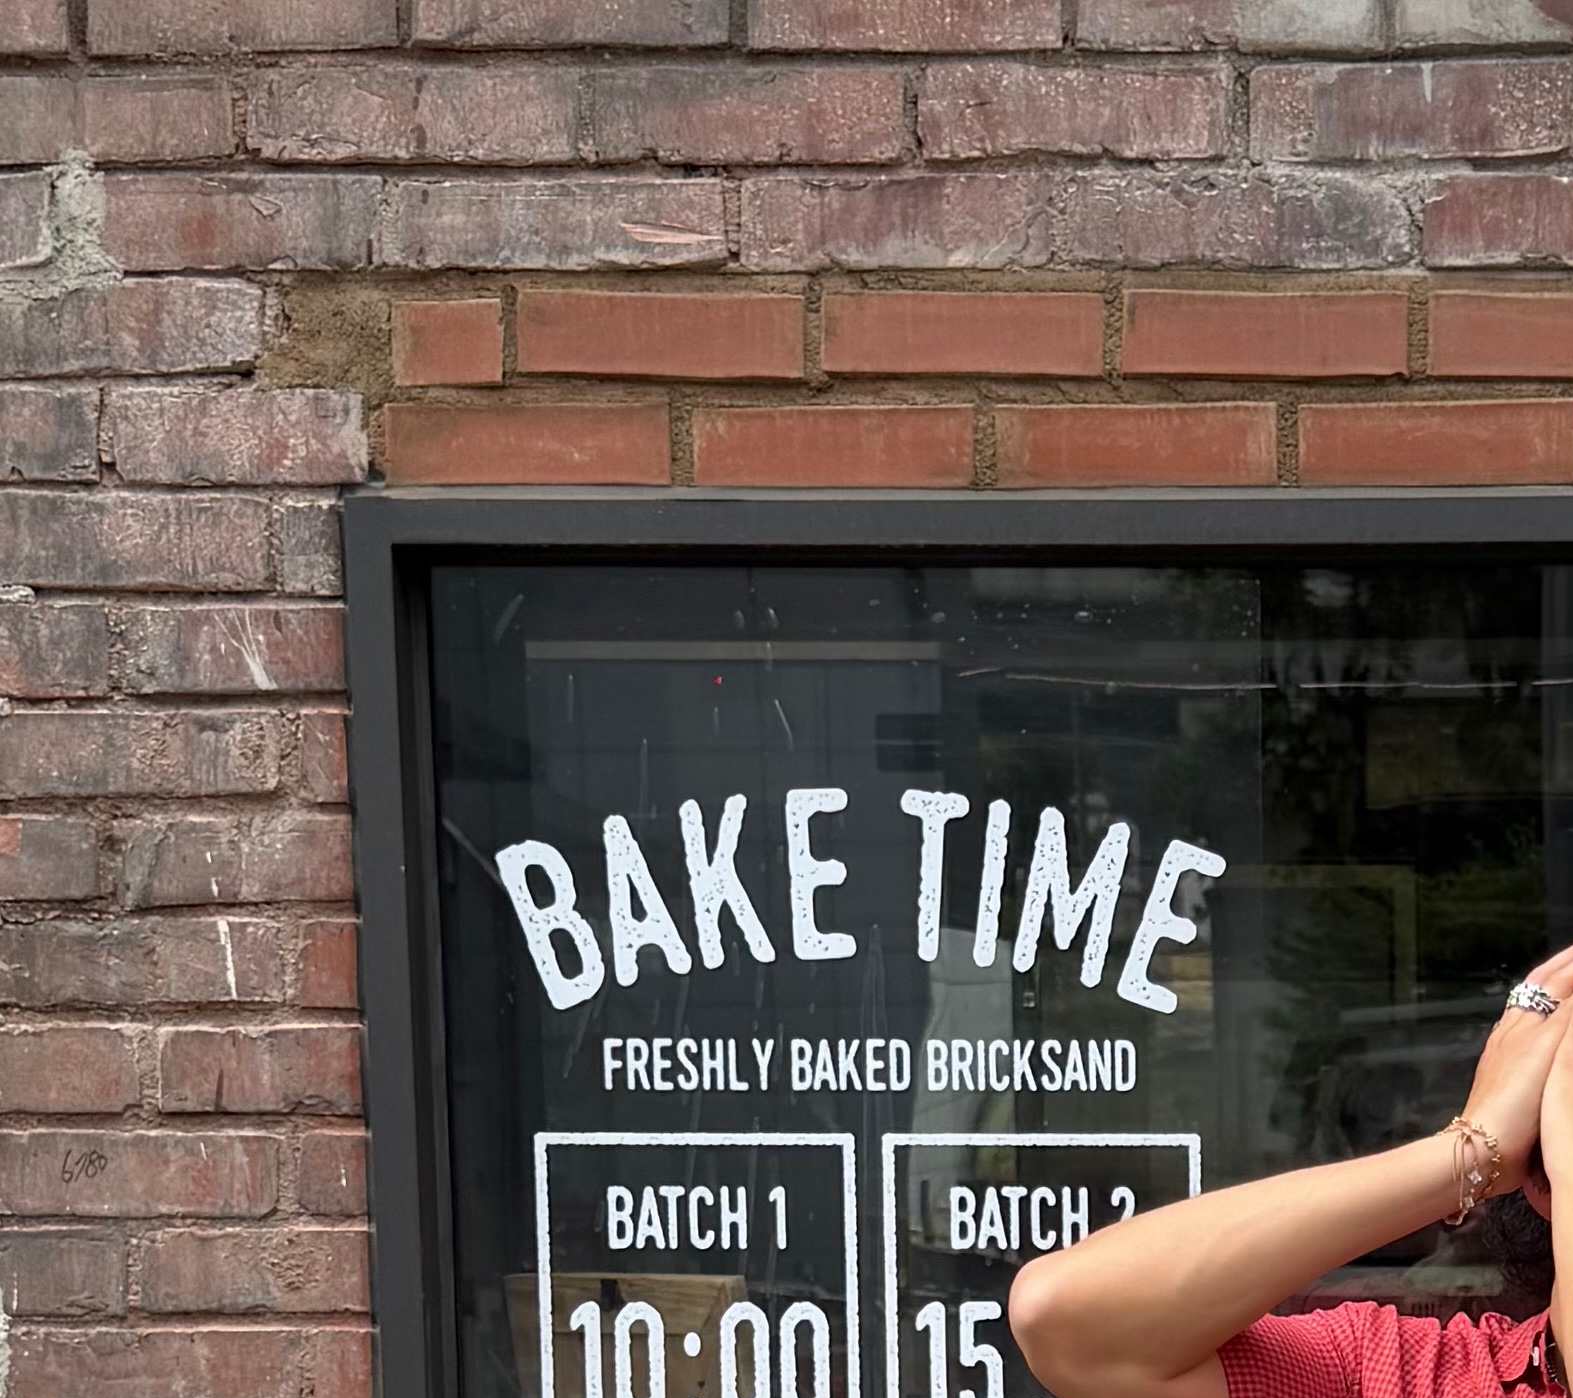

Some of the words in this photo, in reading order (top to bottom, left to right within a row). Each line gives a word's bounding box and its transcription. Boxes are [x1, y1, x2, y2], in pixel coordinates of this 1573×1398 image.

[494, 787, 858, 1011] BAKE
[899, 787, 1228, 1015] TIME
[602, 1036, 776, 1092] FRESHLY
[789, 1037, 912, 1092] BAKED
[925, 1037, 1137, 1093] BRICKSAND
[605, 1184, 749, 1251] BATCH
[767, 1184, 788, 1251] 1
[948, 1184, 1090, 1251] BATCH
